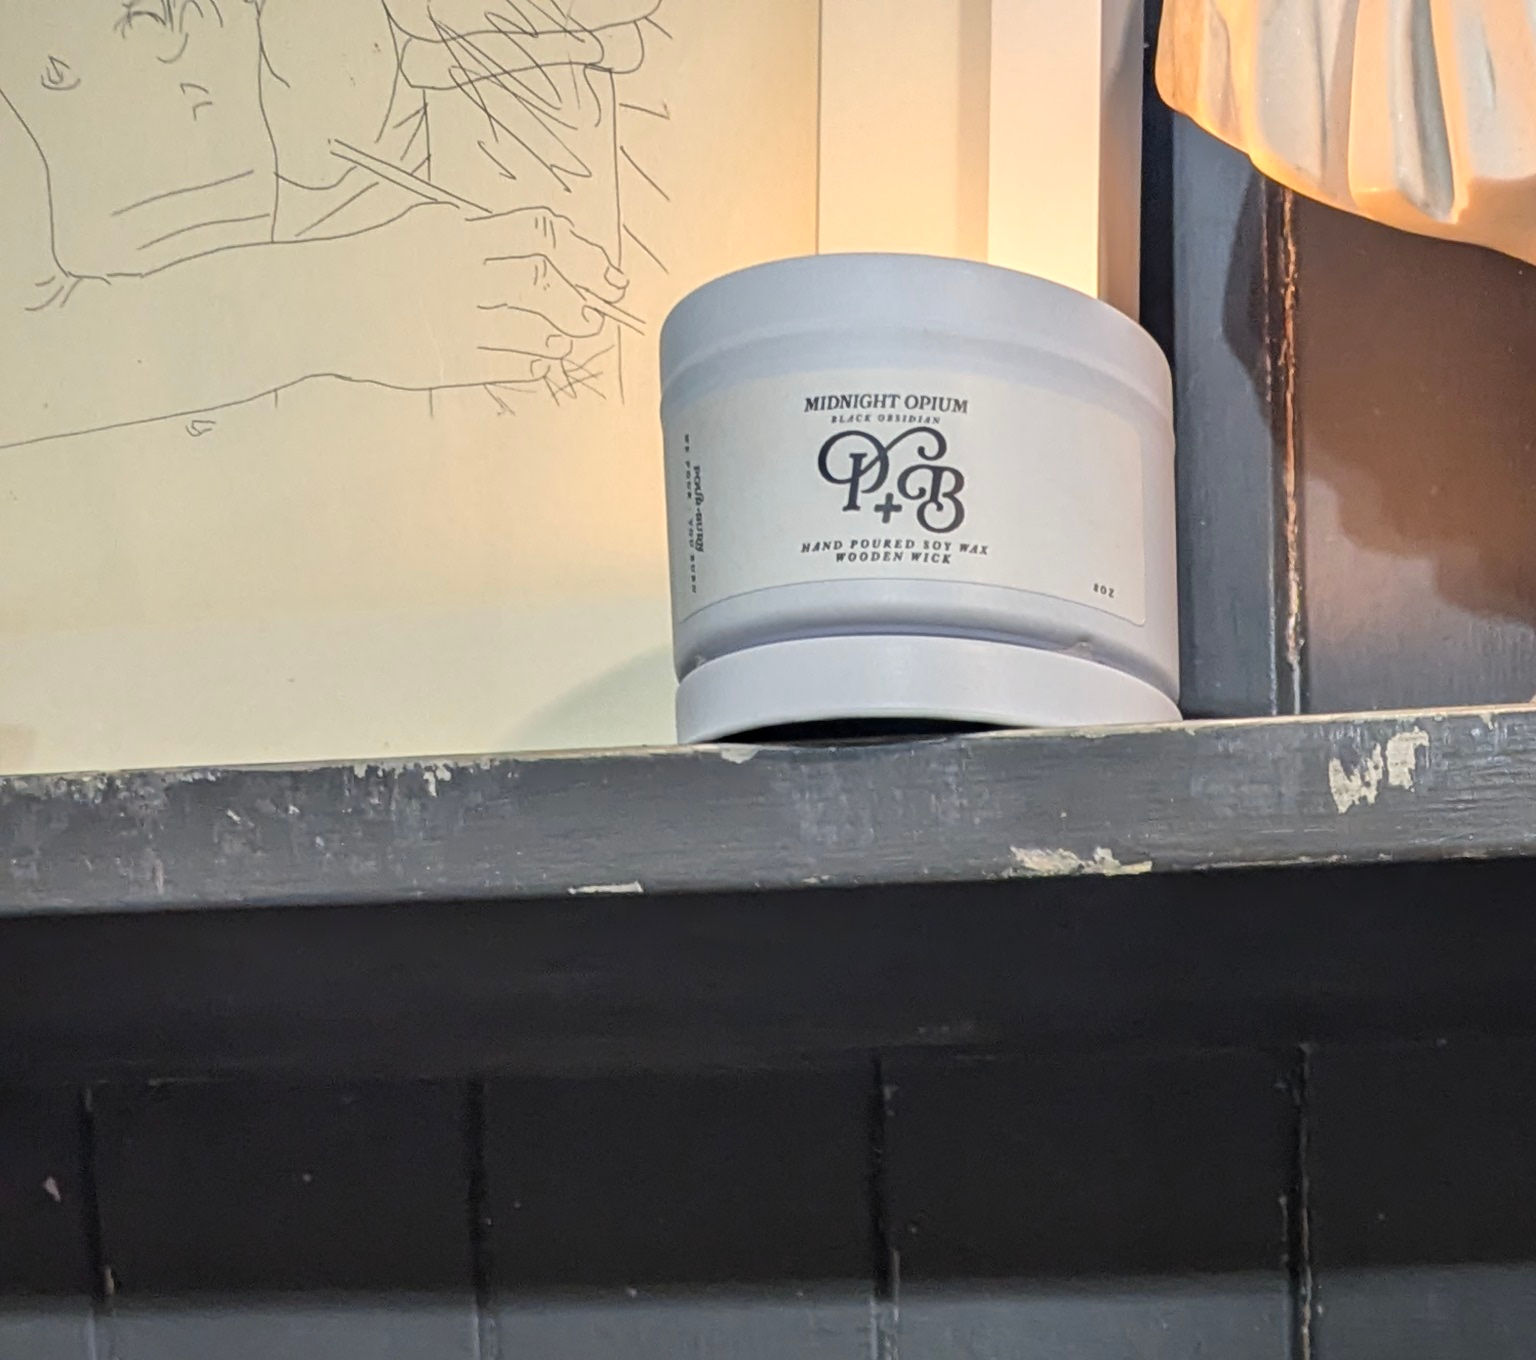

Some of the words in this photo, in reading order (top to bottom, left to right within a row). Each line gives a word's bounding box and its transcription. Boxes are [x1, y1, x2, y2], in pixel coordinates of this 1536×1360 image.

[803, 394, 900, 413] MIDNIGHT
[904, 394, 968, 413] OPIUM
[831, 414, 871, 424] BLACK
[877, 414, 941, 424] OBSIDIAN
[801, 540, 843, 553] HAND
[850, 539, 915, 549] POURED
[923, 539, 952, 551] SOY
[959, 543, 989, 556] WAX
[835, 552, 903, 563] WOODEN
[911, 552, 952, 564] WICK
